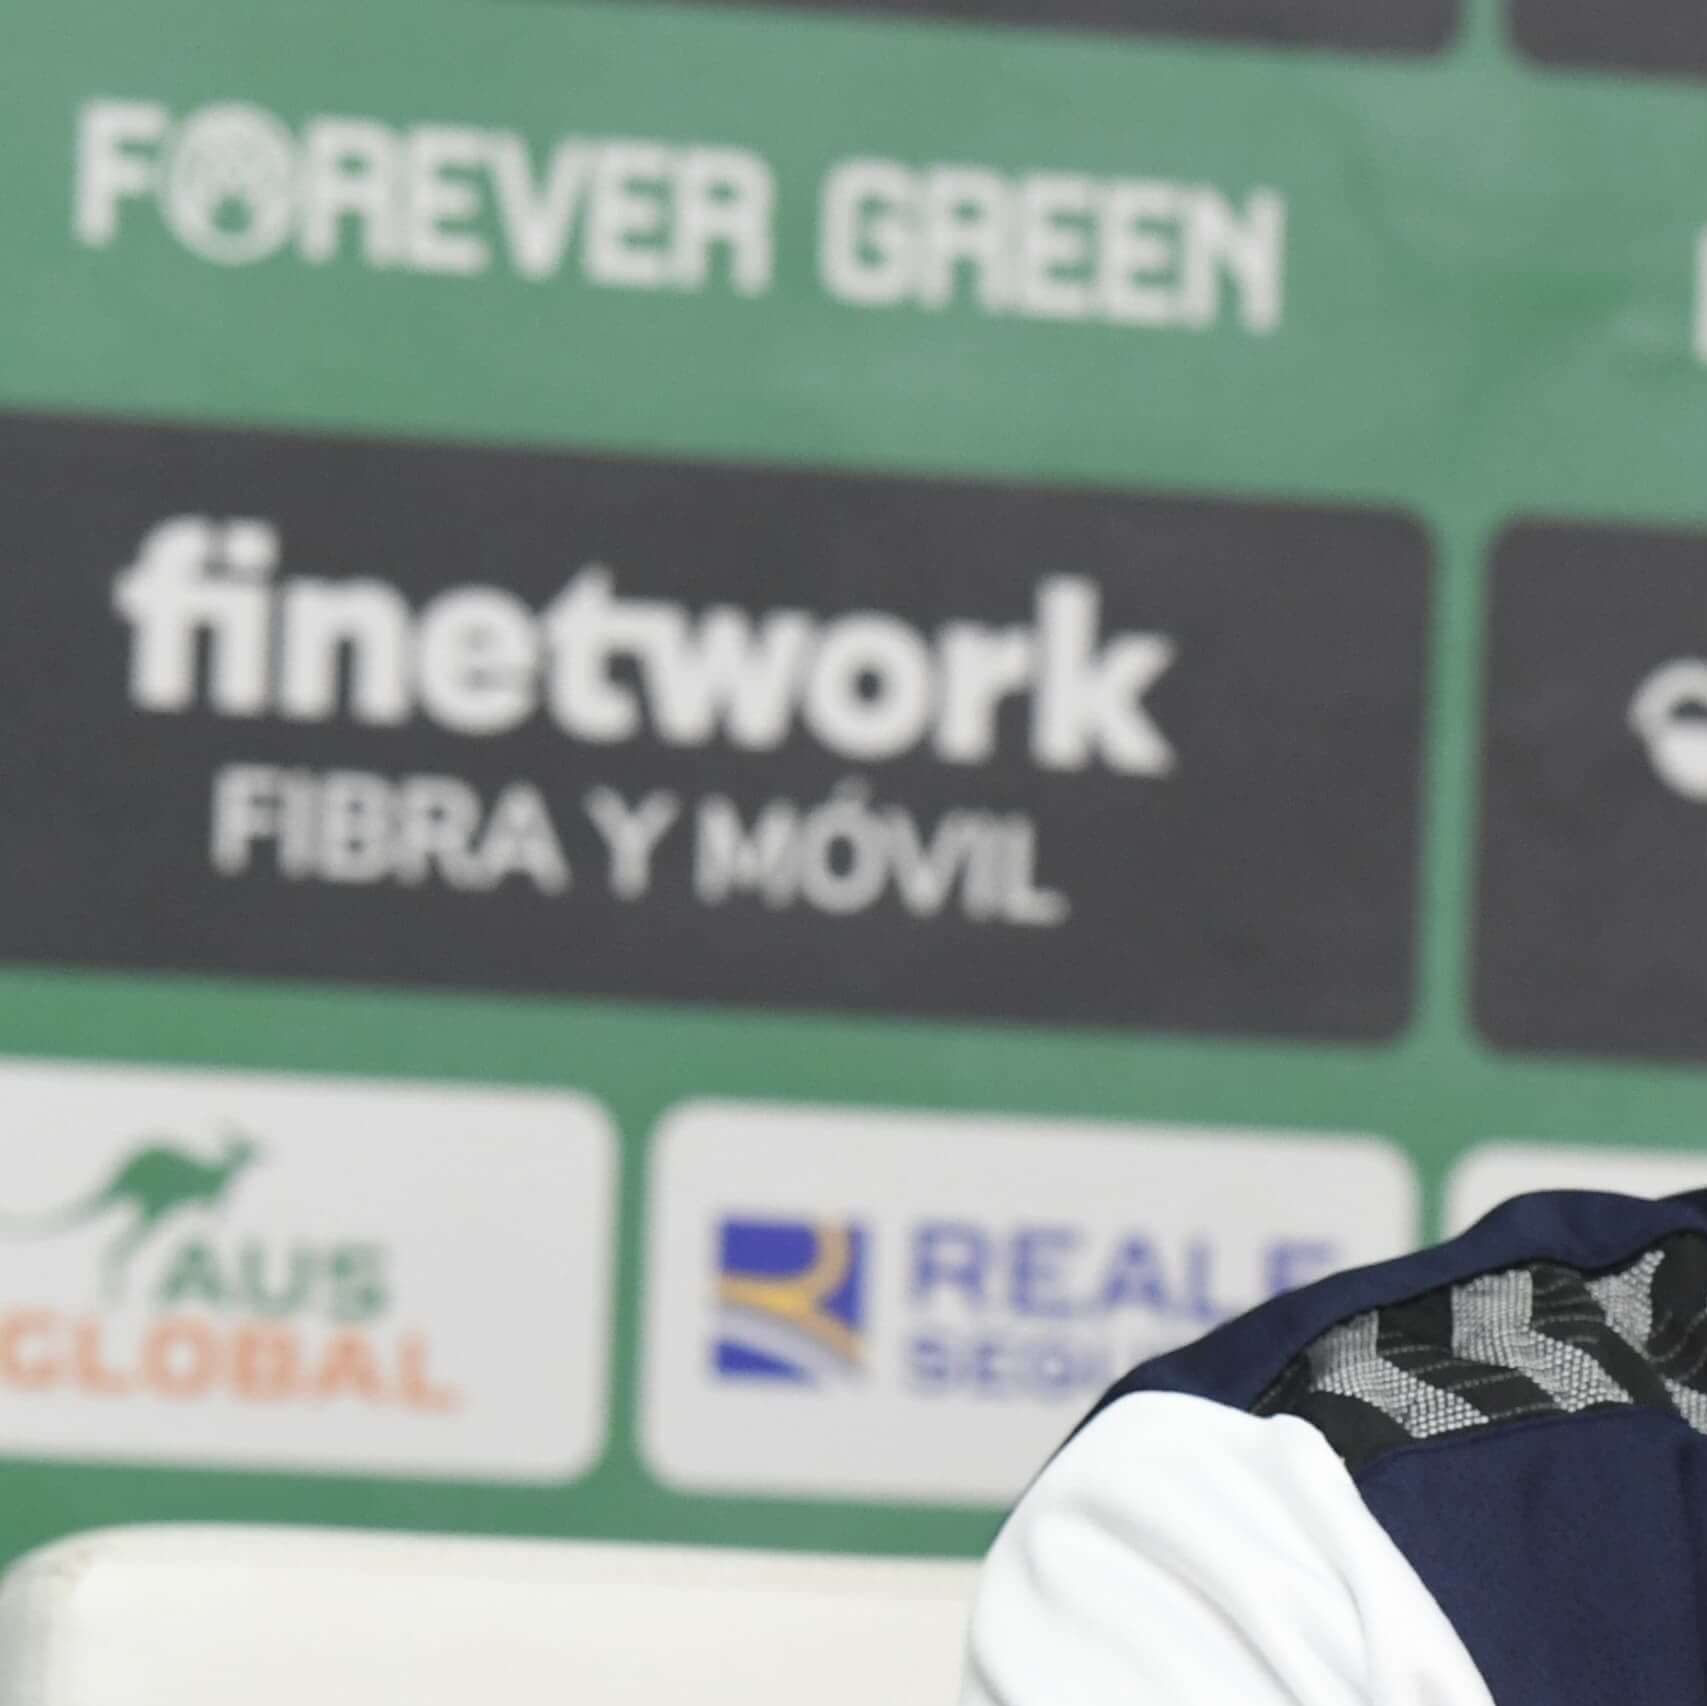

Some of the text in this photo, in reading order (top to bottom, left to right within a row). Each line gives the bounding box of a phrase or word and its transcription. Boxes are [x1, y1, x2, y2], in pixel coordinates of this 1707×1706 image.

[75, 100, 1287, 333] FOREVER GREEN
[115, 515, 1173, 777] finetwork
[213, 765, 1070, 926] FIBRA Y MÓVIL
[152, 1230, 393, 1325] AUS
[0, 1306, 466, 1415] GLOBAL
